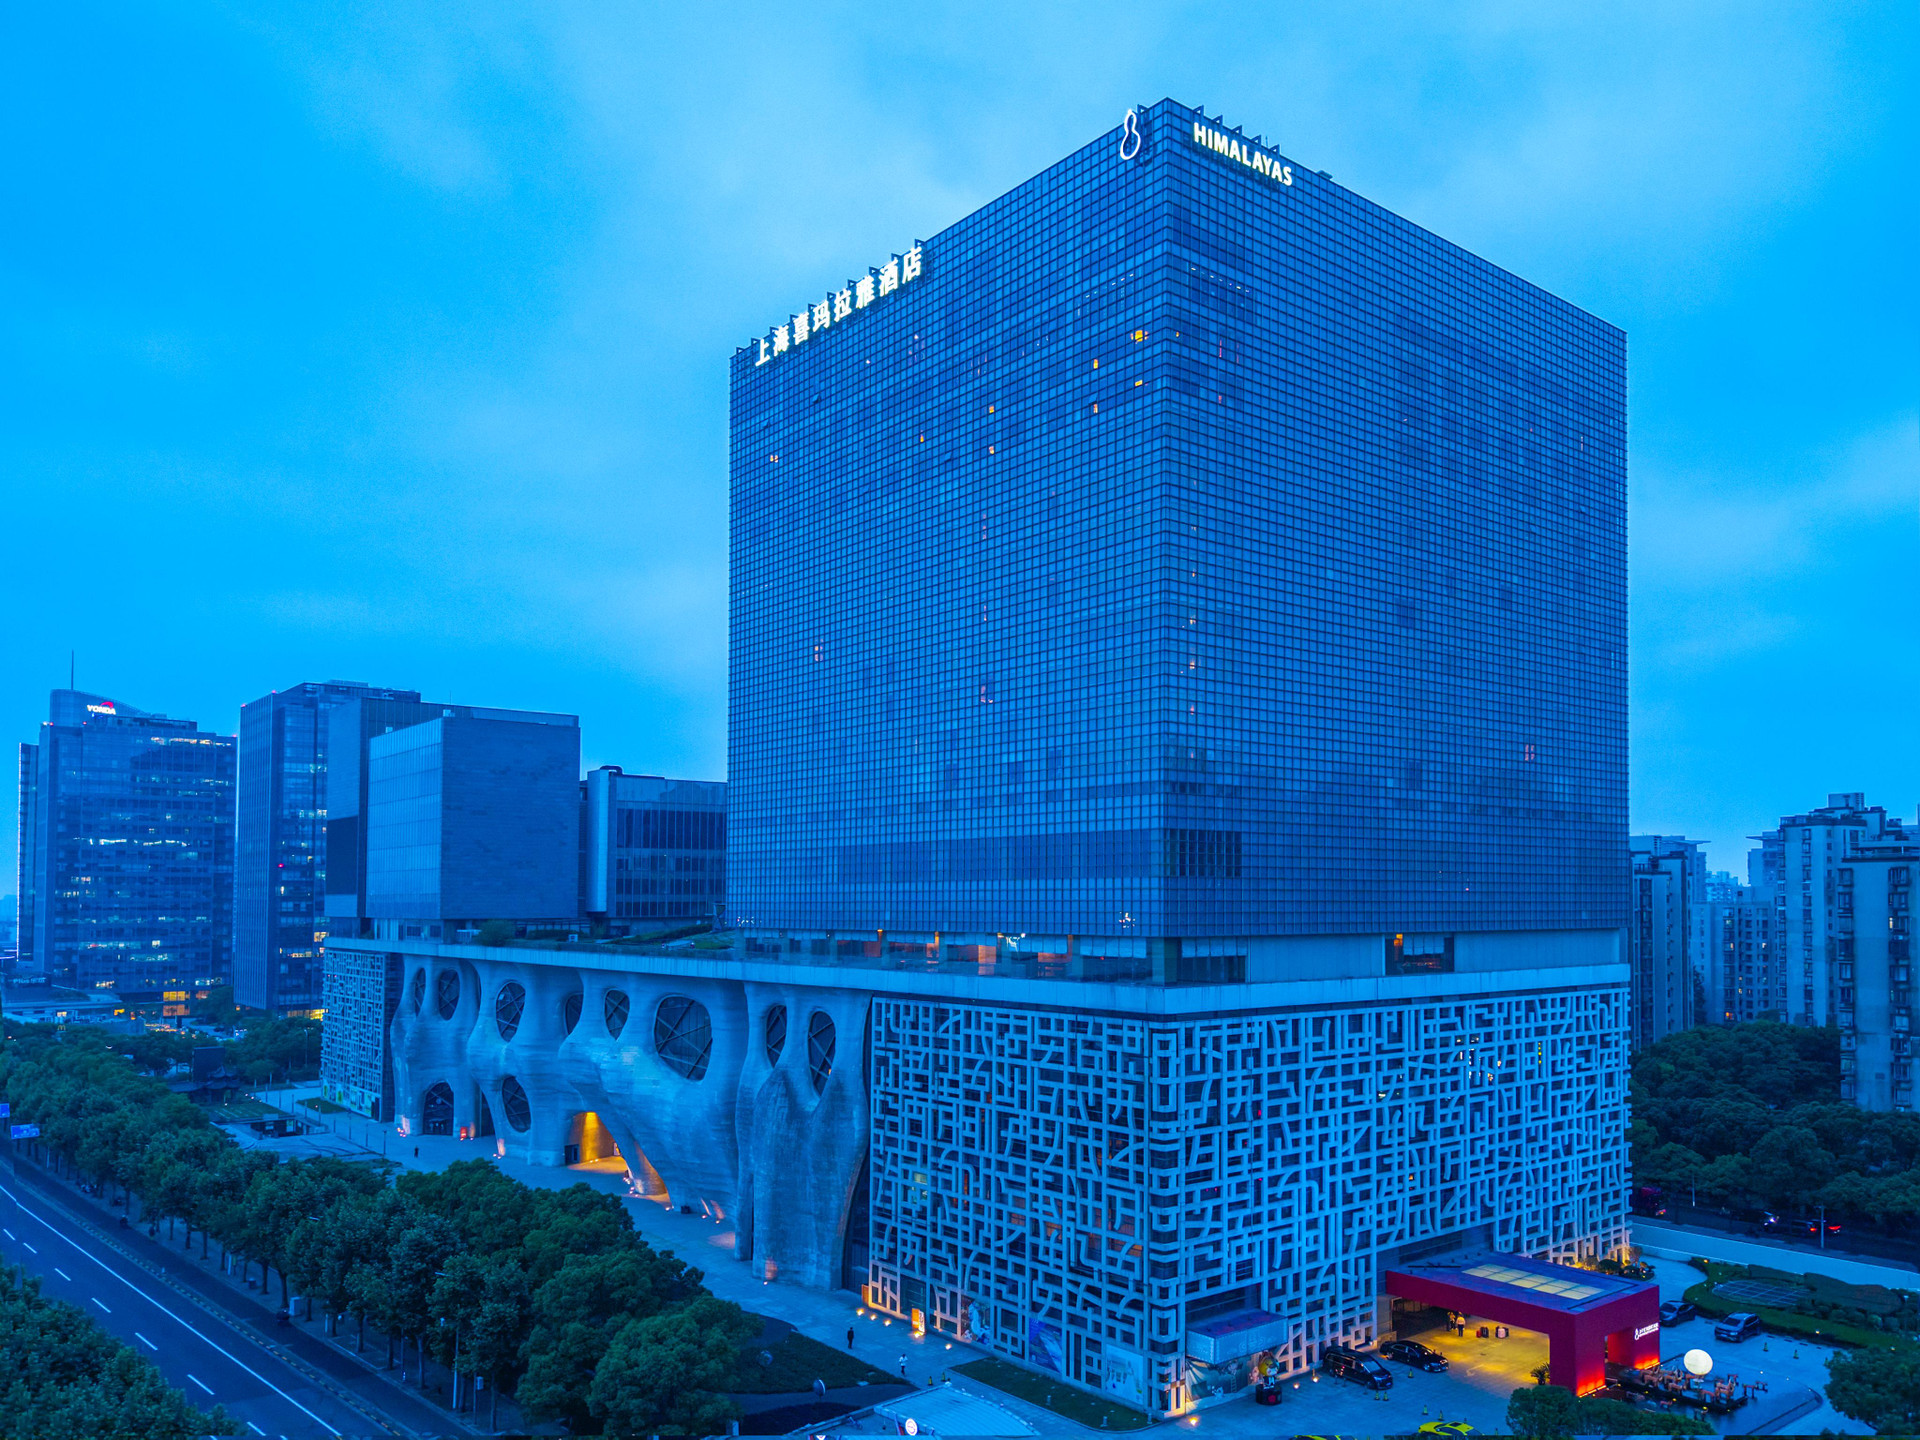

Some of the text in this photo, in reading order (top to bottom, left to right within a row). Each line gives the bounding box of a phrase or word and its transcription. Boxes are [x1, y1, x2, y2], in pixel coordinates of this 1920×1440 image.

[1194, 122, 1293, 186] HIMALAYAS
[755, 246, 922, 367] 上海喜玛拉雅酒店
